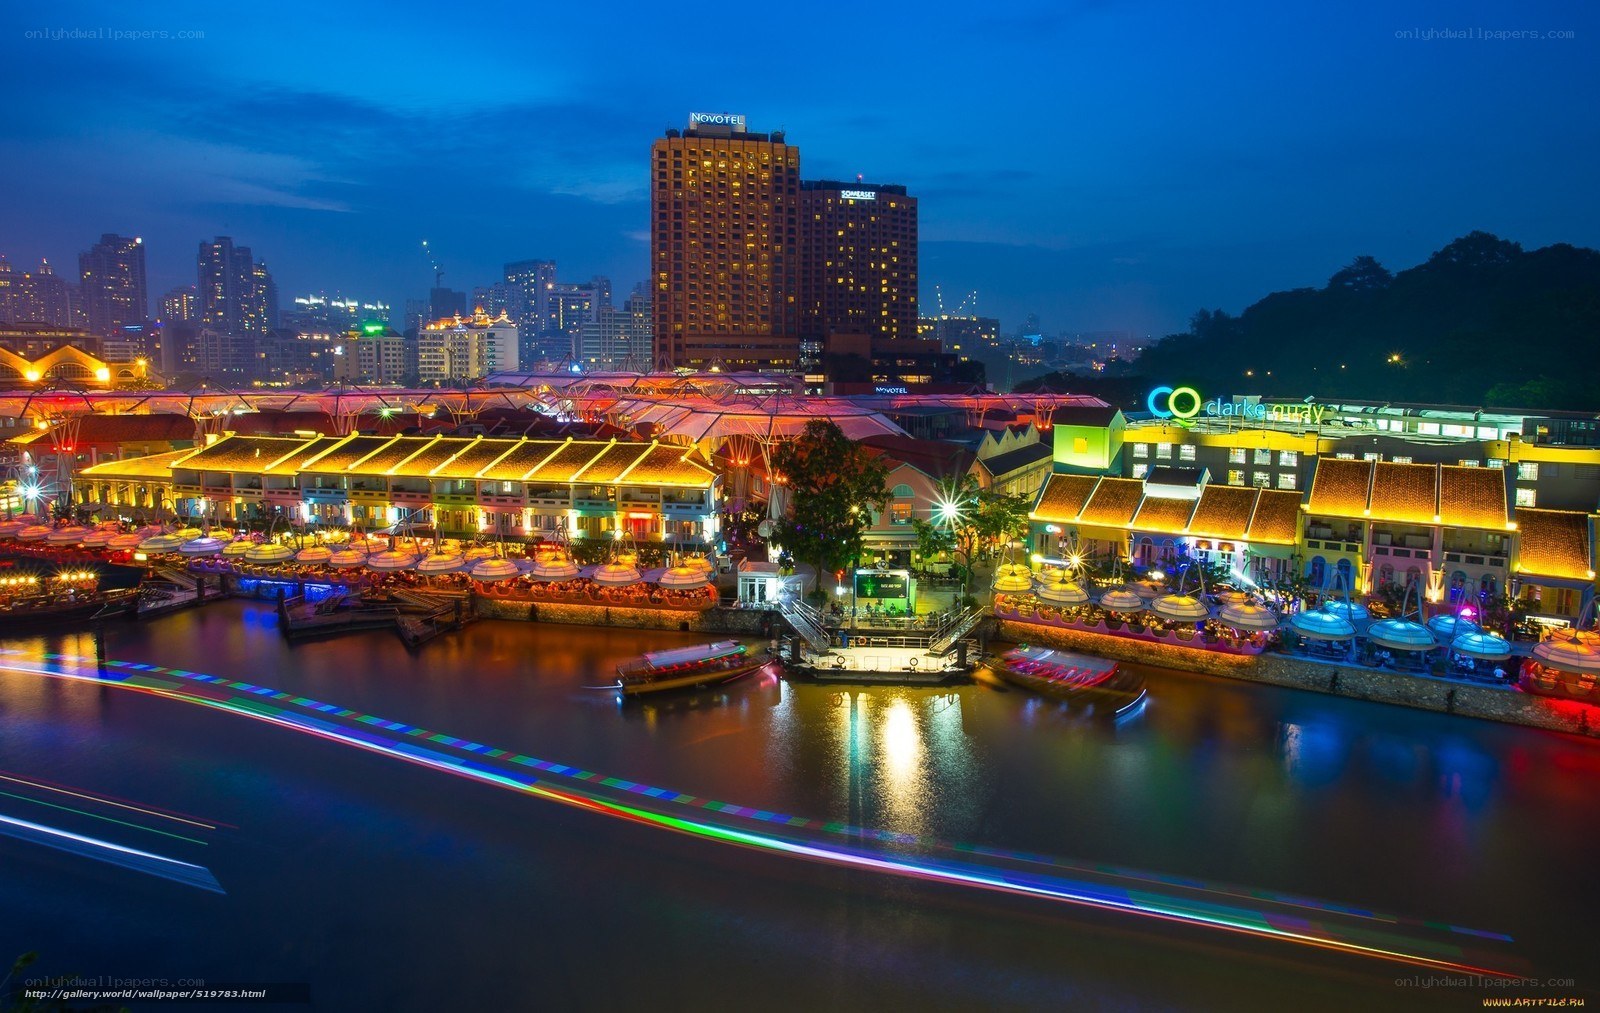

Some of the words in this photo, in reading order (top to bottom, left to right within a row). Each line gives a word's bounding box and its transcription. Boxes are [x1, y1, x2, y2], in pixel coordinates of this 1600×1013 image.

[691, 112, 744, 125] NOVOTEL
[841, 190, 876, 199] SOMERSET
[875, 386, 908, 394] NOVOTEL
[1206, 398, 1266, 418] clarke
[1272, 403, 1325, 425] quay
